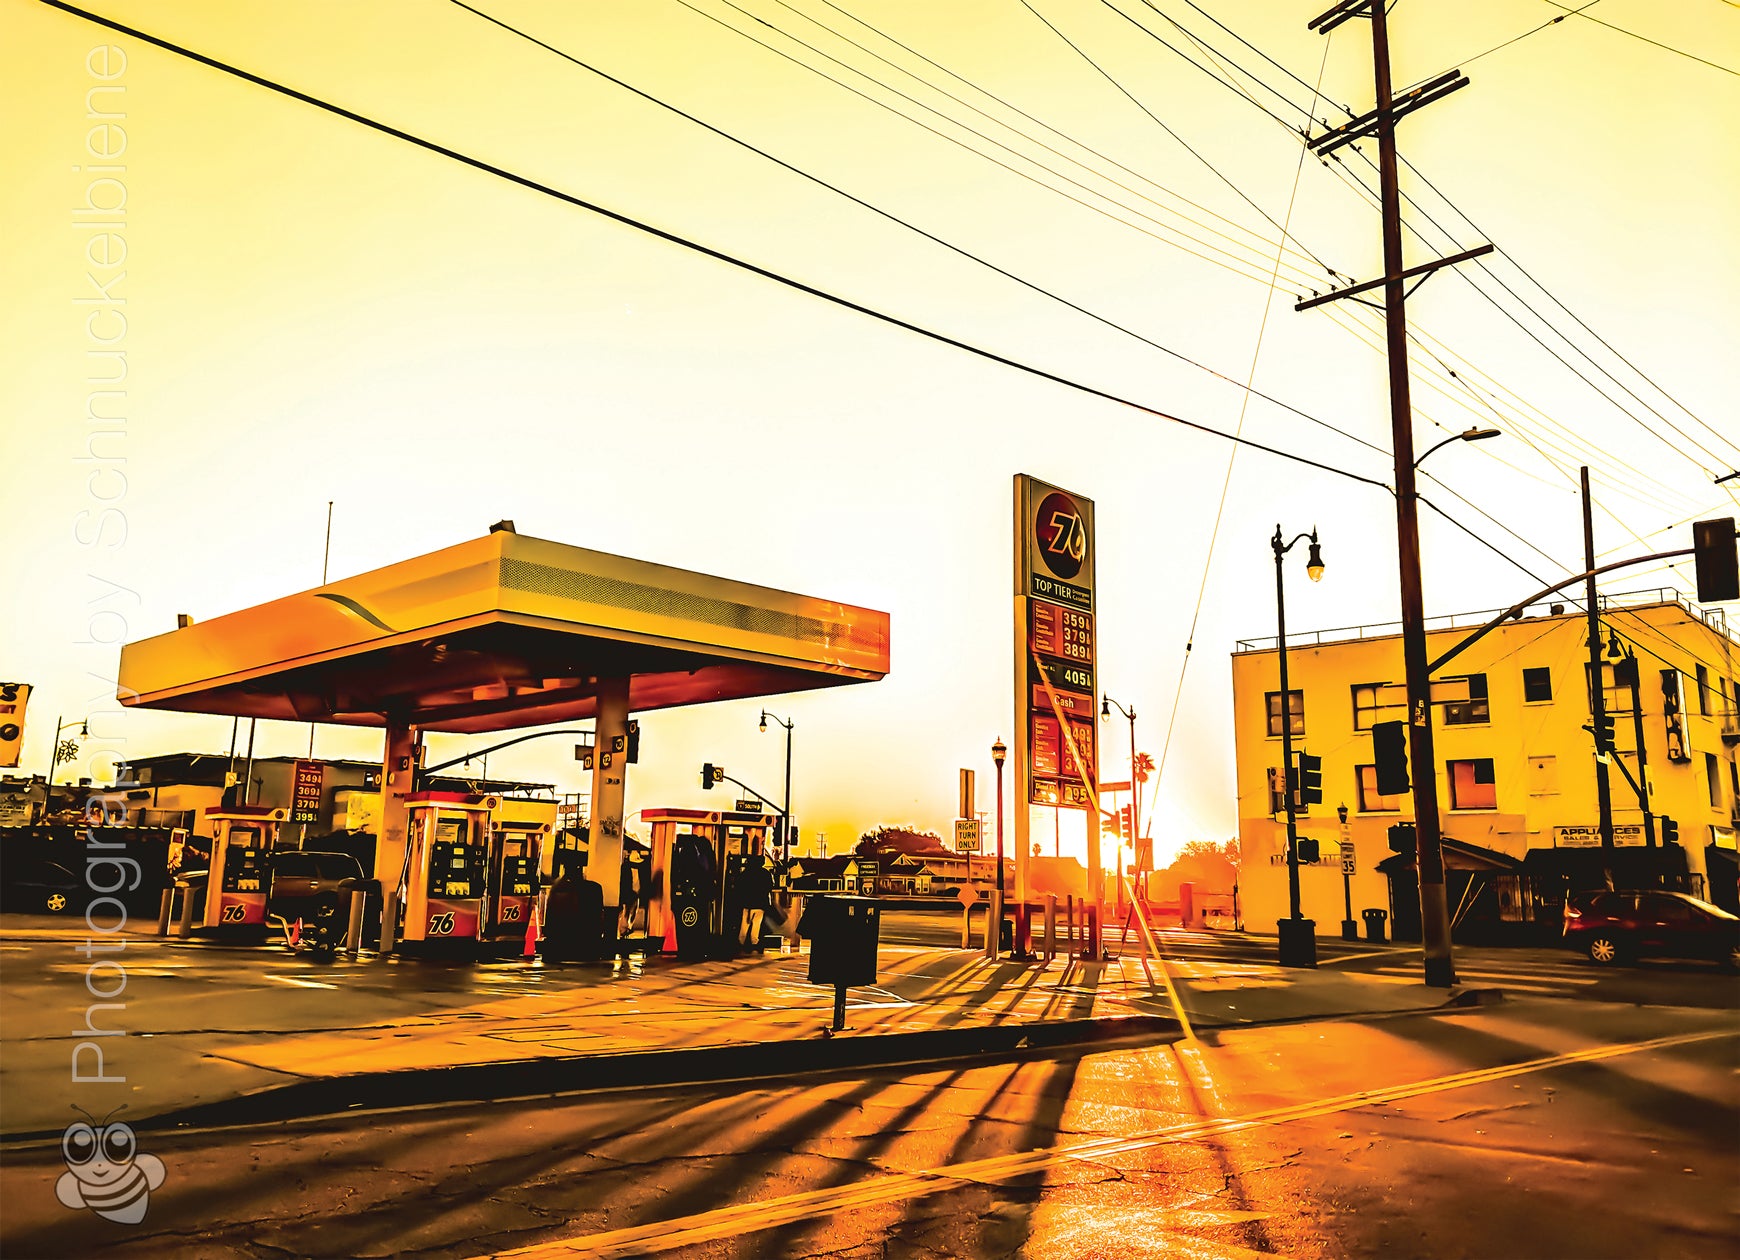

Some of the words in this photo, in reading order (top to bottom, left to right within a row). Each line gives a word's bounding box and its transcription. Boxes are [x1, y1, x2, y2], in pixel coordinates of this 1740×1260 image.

[1048, 511, 1087, 562] 76
[1034, 577, 1052, 593] TOP
[1053, 583, 1072, 599] TIER
[1054, 694, 1074, 709] Cash
[957, 822, 977, 831] RIGHT
[1560, 827, 1641, 836] APPLICES
[959, 831, 976, 839] TURN
[958, 840, 976, 849] ONLY
[1342, 860, 1355, 873] 35
[222, 903, 247, 923] 76
[502, 905, 521, 921] 76
[684, 911, 696, 923] 76
[428, 911, 456, 935] 76
